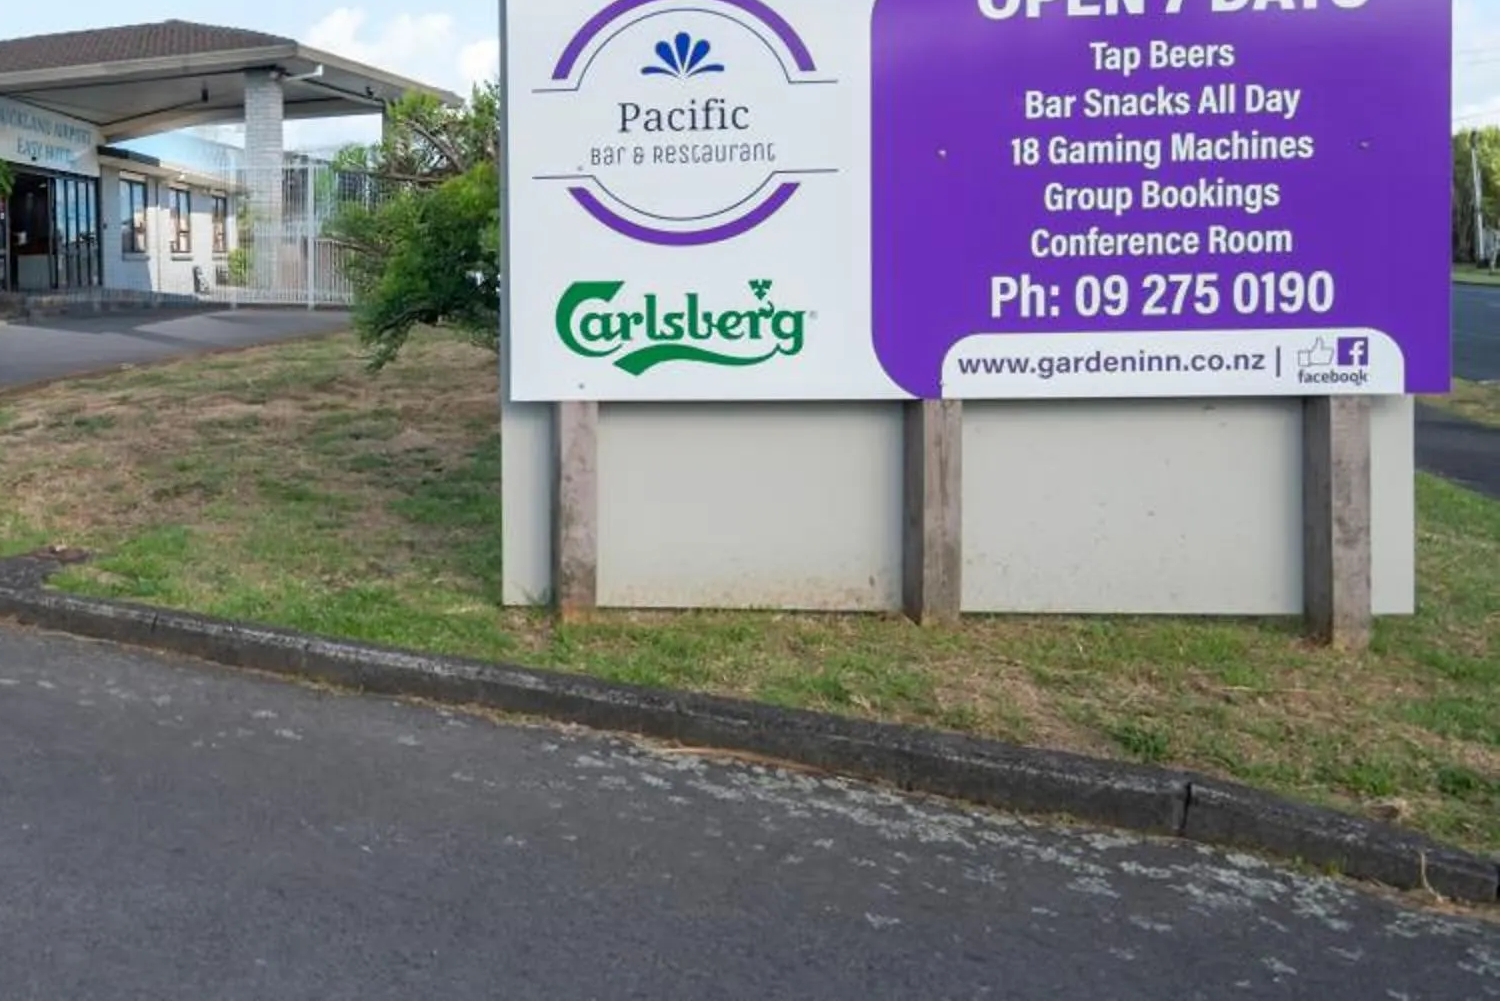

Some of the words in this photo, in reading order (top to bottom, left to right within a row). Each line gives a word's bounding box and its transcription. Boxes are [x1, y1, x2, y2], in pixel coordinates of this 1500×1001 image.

[1089, 41, 1141, 77] Tap
[1149, 40, 1235, 69] Beers
[617, 97, 750, 134] Pacific
[1024, 90, 1077, 119] Bar
[1083, 86, 1191, 118] Snacks
[1198, 83, 1236, 115] All
[1245, 84, 1301, 119] Day
[632, 145, 645, 165] &
[1011, 137, 1041, 166] 18
[1048, 133, 1162, 170] Gaming
[1170, 130, 1315, 162] Machines
[1044, 182, 1133, 216] Group
[1141, 177, 1281, 214] Bookings
[1030, 226, 1199, 258] Conference
[1208, 224, 1293, 255] Room
[990, 274, 1060, 318] Ph:
[1074, 274, 1129, 317] 09
[1141, 272, 1220, 316] 275
[1232, 269, 1335, 314] 0190
[555, 280, 807, 364] Carlsberg
[957, 348, 1266, 379] www.gardeninn.co.nz
[1297, 368, 1368, 386] facebook
